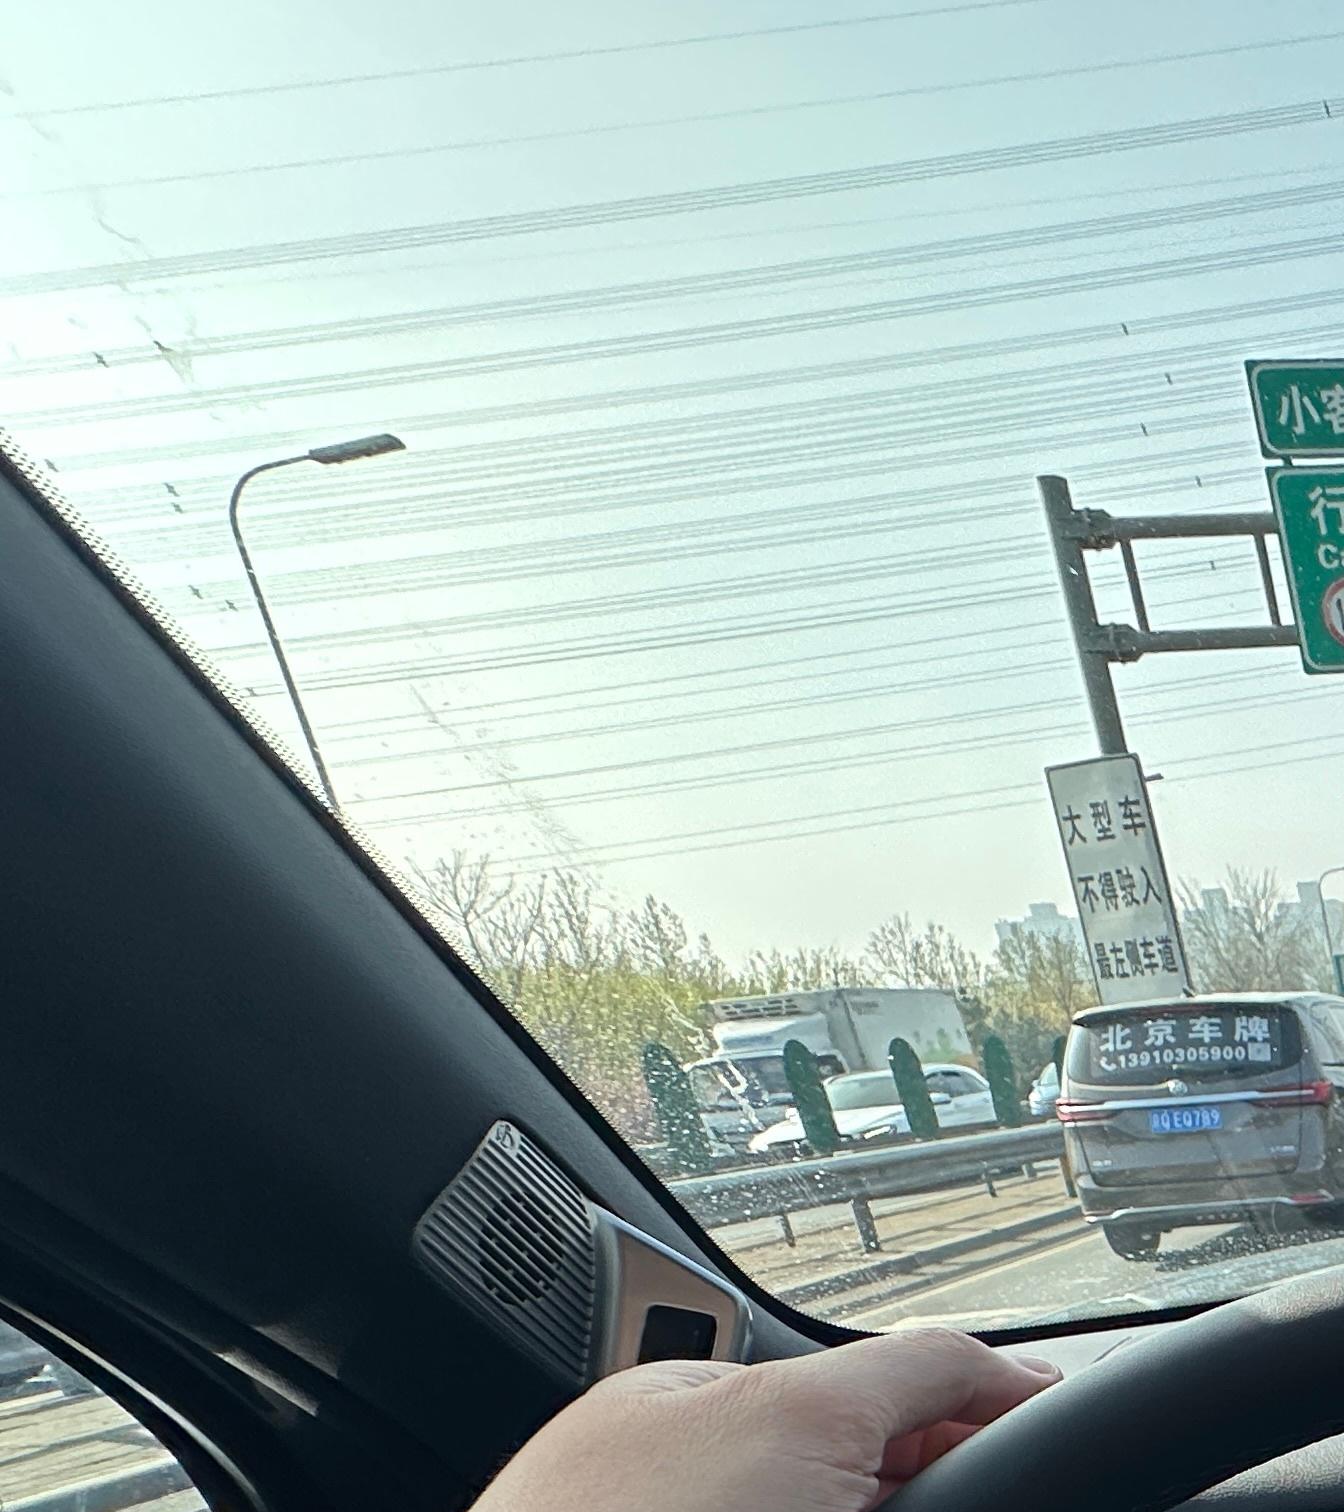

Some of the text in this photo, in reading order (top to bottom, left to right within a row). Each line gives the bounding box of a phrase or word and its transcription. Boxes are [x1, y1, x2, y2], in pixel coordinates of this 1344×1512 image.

[1062, 795, 1147, 847] 大型车
[1077, 865, 1163, 914] 不得驶入
[1094, 935, 1179, 980] 最左侧车道
[1100, 1015, 1271, 1052] 北京车牌
[1118, 1046, 1246, 1069] 13910305900
